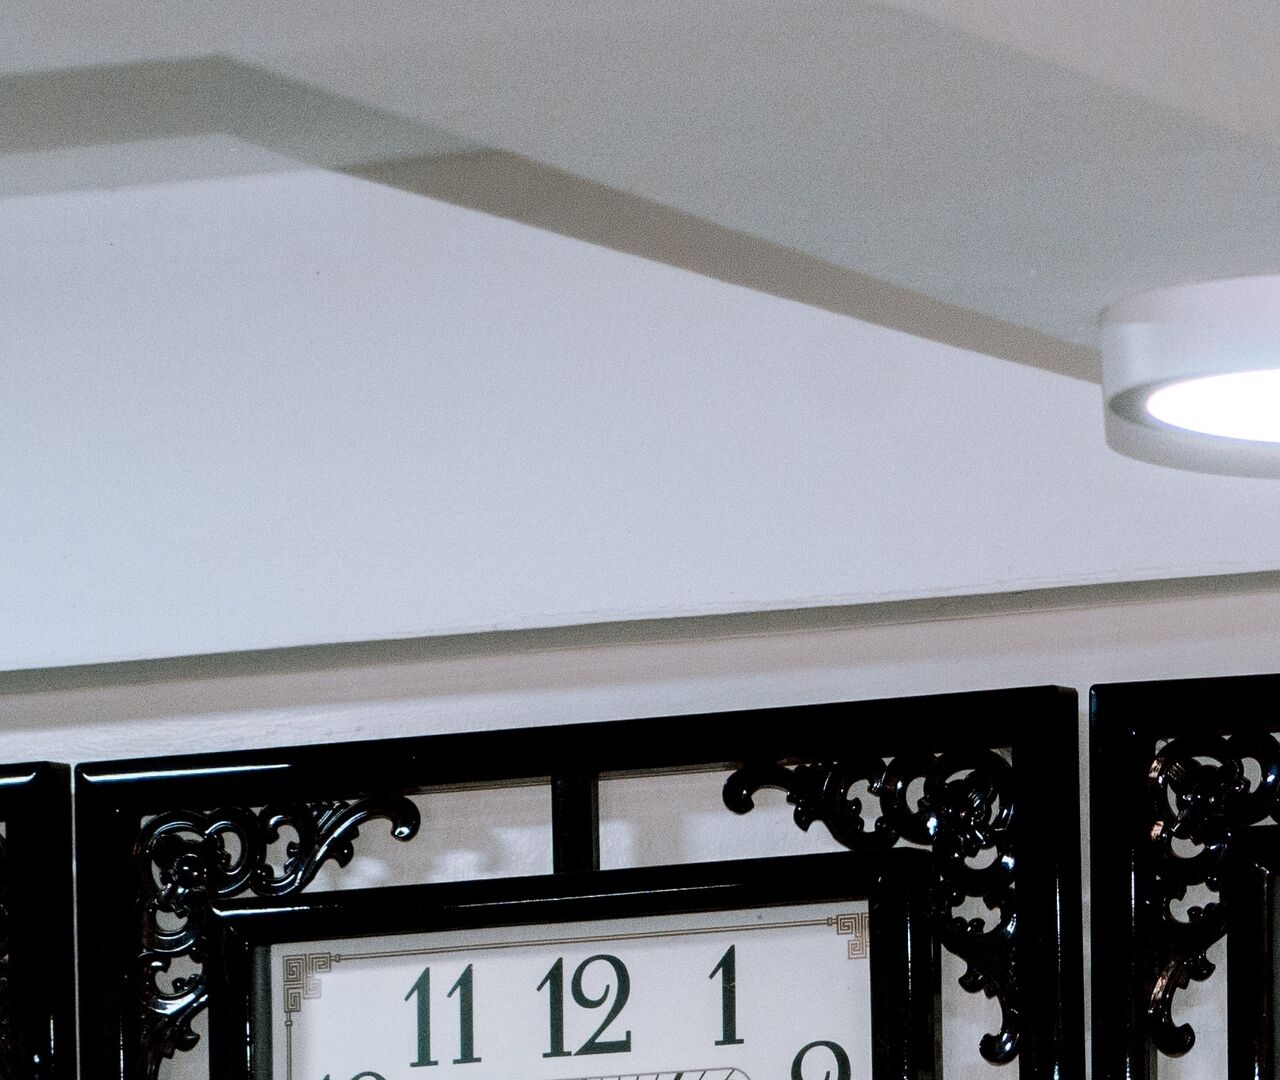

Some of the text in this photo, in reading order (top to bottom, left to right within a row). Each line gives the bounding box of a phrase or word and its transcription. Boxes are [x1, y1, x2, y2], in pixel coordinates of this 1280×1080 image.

[405, 964, 481, 1067] 11
[537, 955, 631, 1058] 12
[710, 945, 744, 1045] 1
